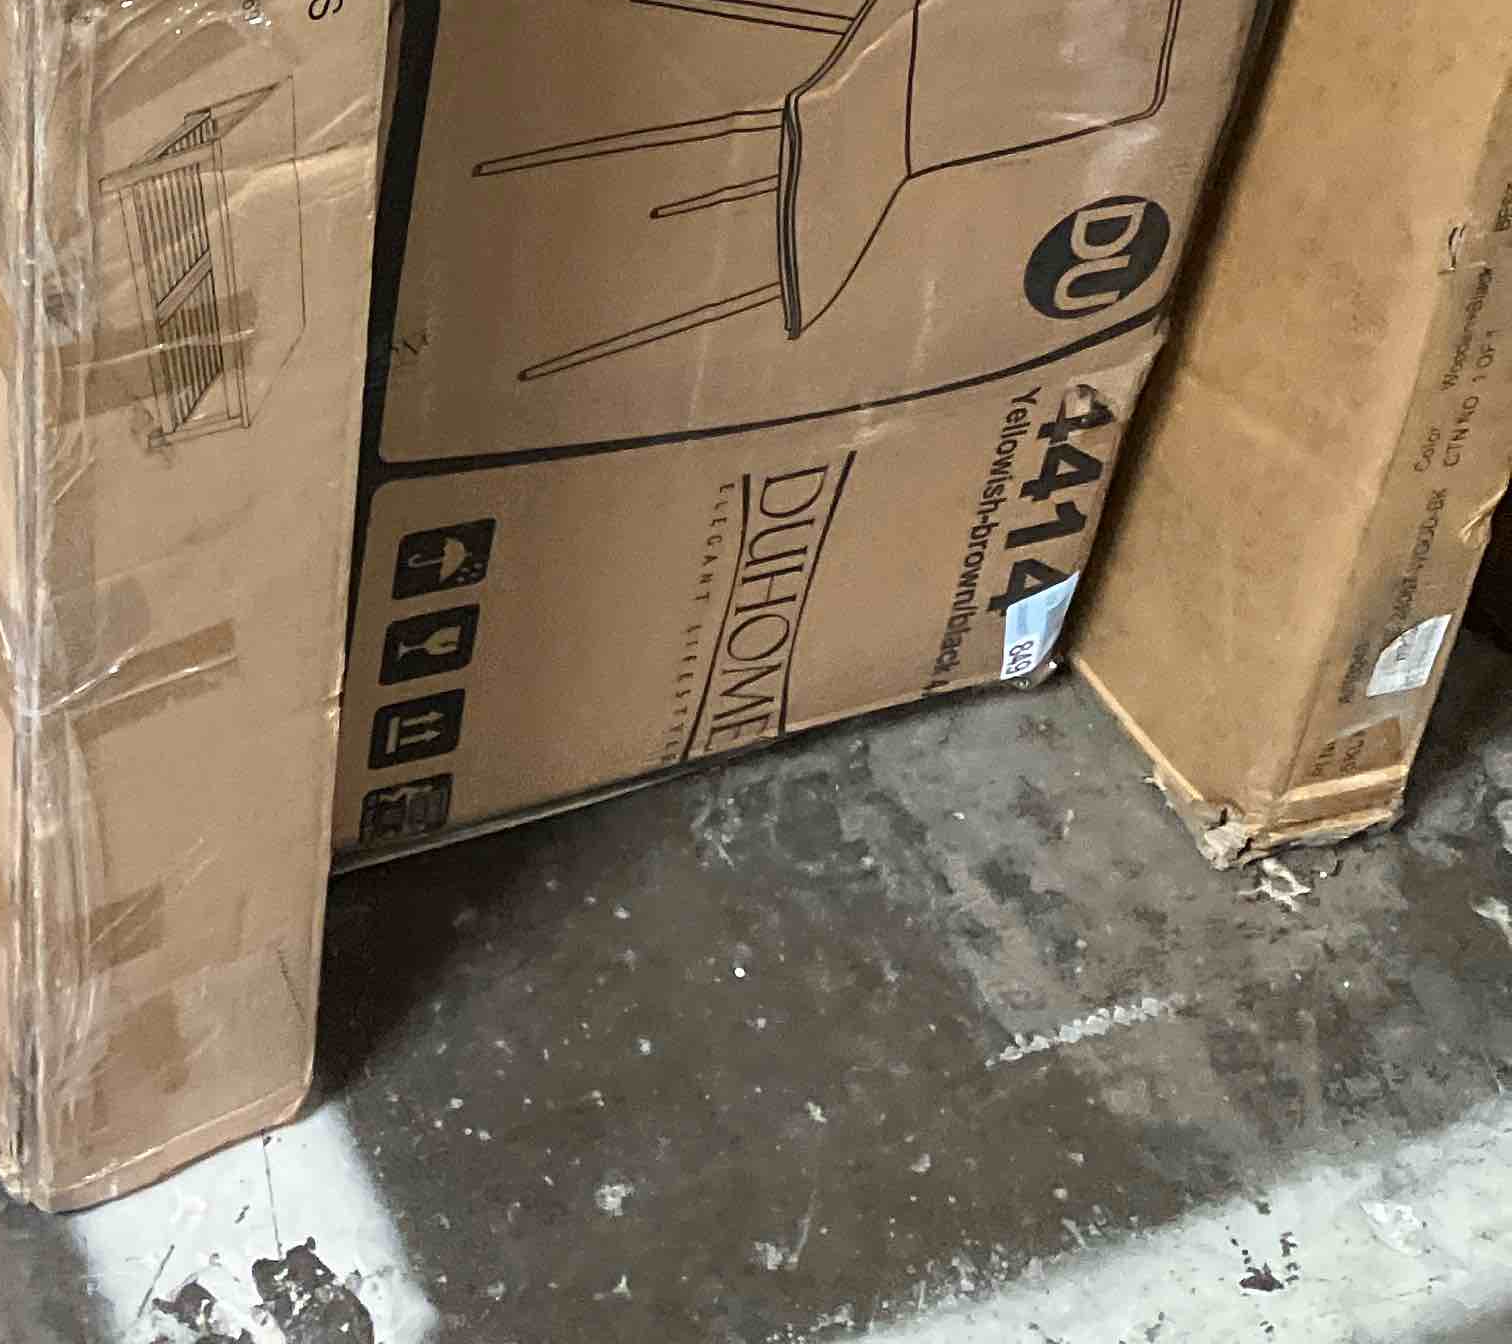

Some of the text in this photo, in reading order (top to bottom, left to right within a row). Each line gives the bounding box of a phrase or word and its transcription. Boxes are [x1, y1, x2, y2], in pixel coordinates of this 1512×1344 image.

[1051, 199, 1148, 311] DU
[697, 481, 737, 604] ELEGANT
[705, 464, 831, 752] DUHOME
